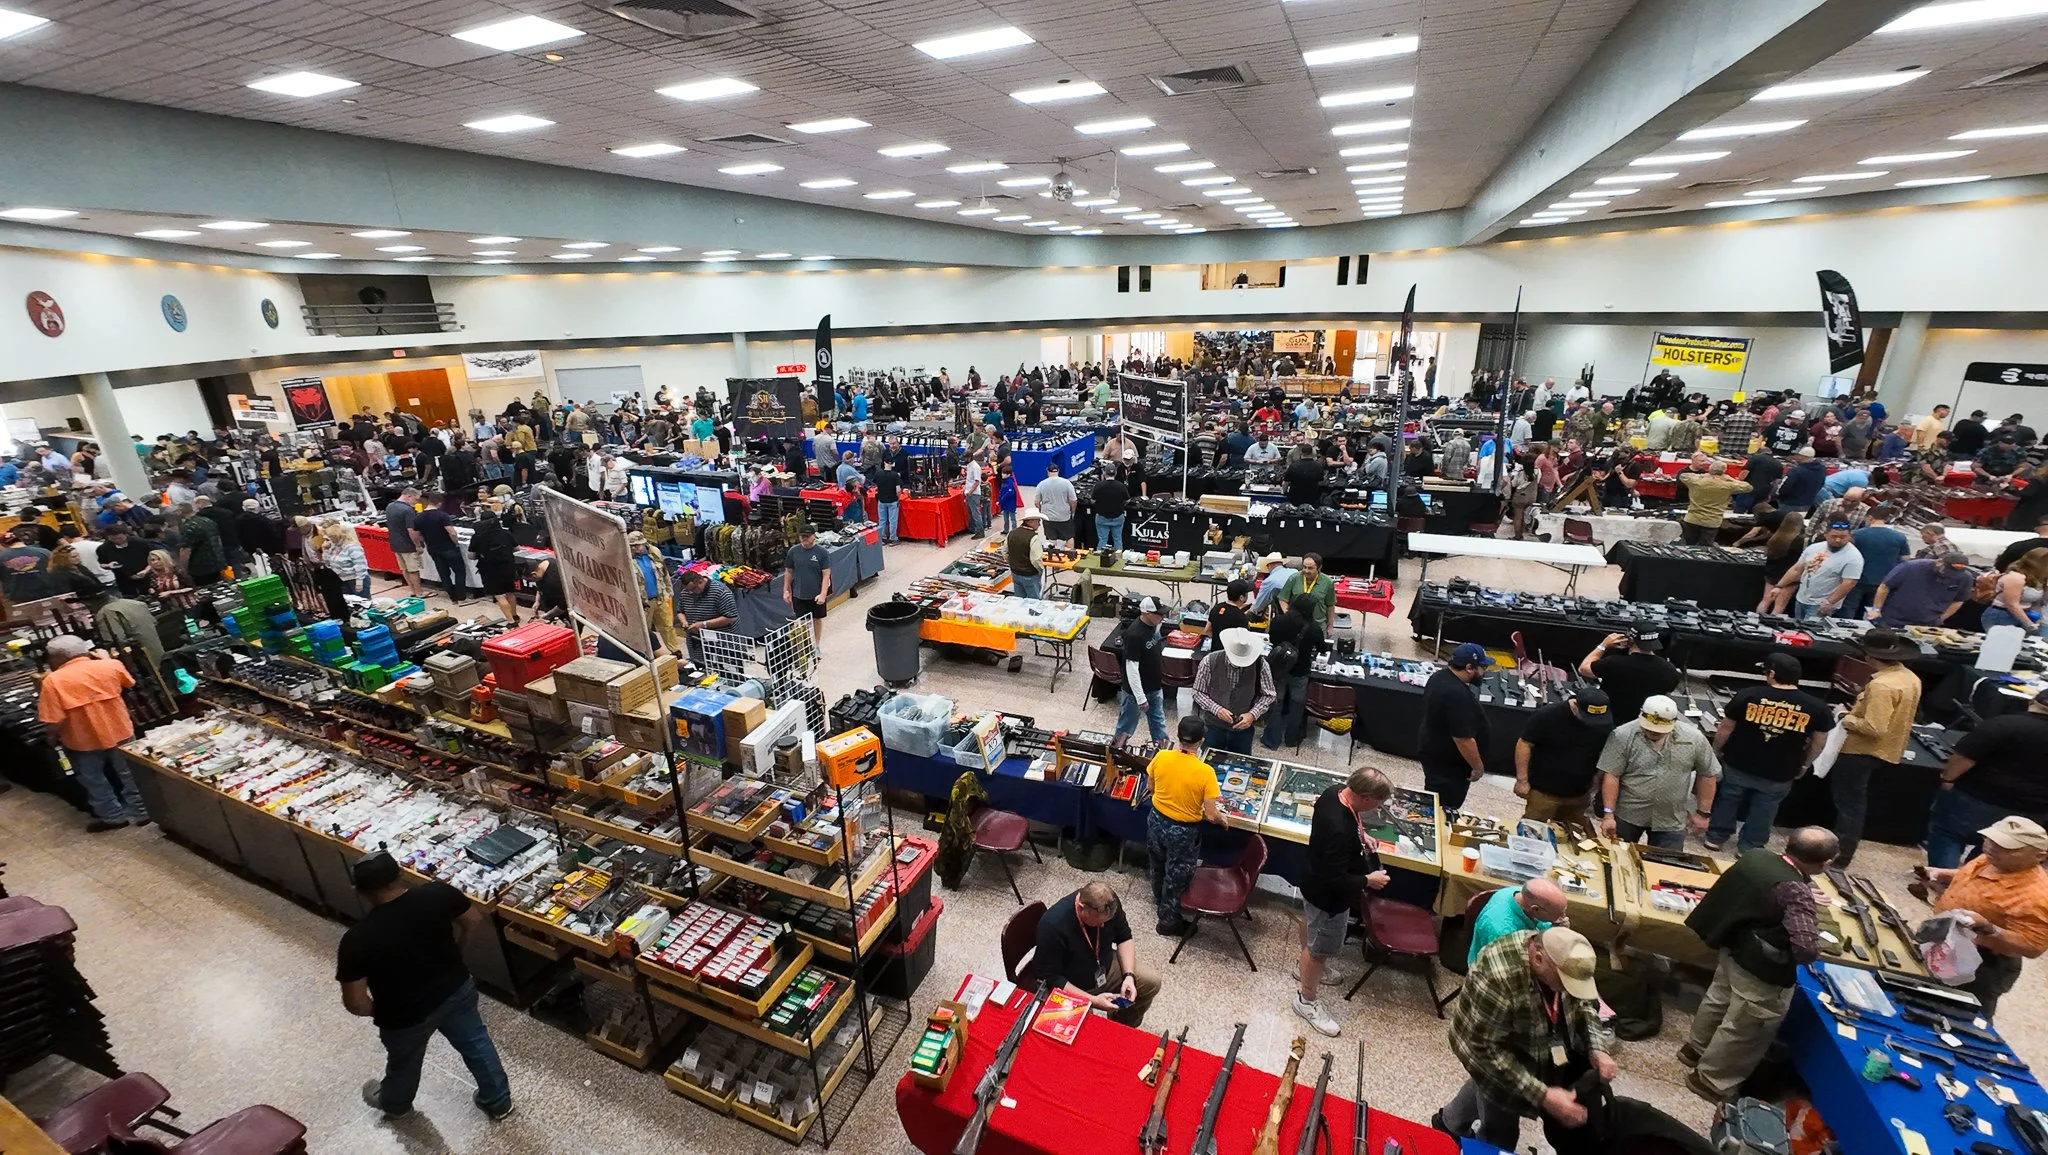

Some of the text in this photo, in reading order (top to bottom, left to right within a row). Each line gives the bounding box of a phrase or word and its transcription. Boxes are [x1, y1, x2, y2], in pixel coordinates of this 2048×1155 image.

[1662, 348, 1733, 366] HOLSTERS
[1123, 392, 1151, 407] TAKTEK
[571, 575, 629, 627] SUPPLIES
[1745, 702, 1811, 733] BIGGER
